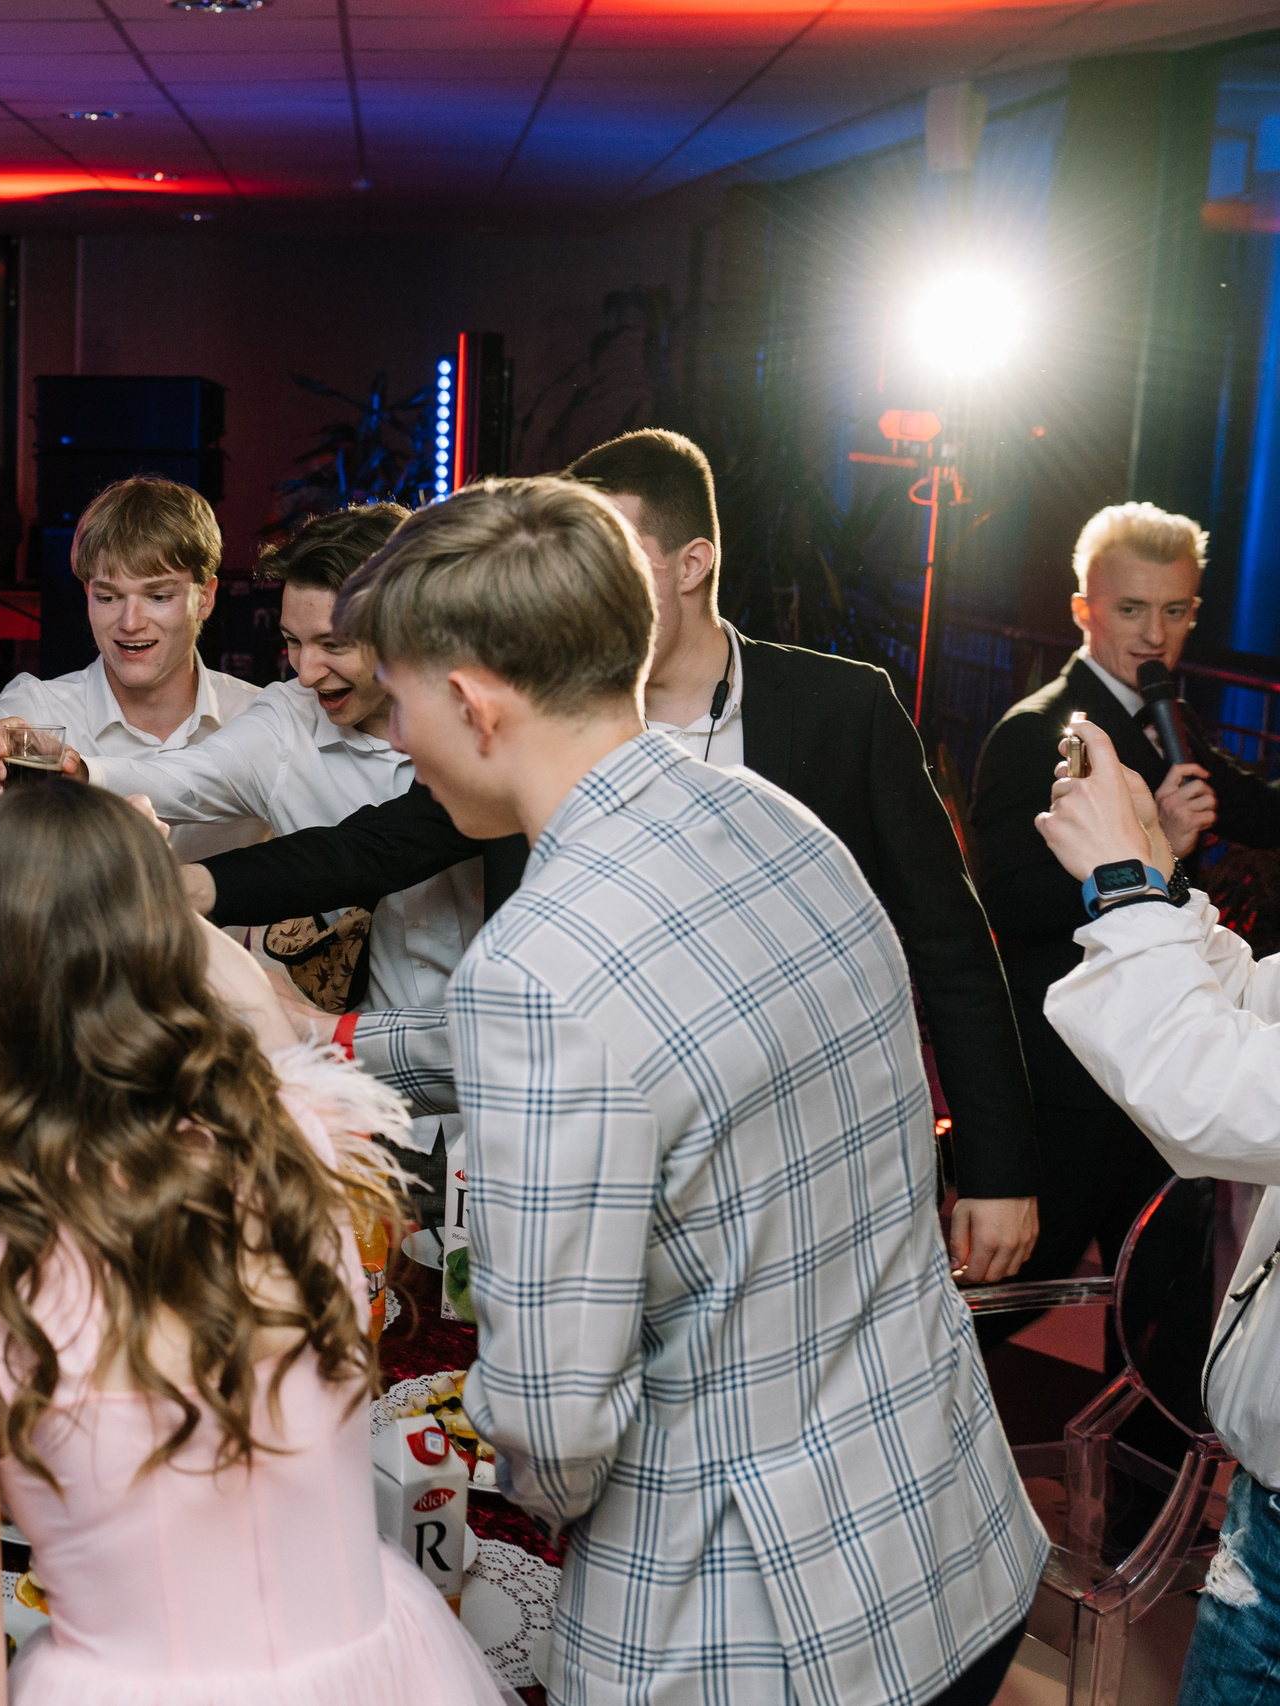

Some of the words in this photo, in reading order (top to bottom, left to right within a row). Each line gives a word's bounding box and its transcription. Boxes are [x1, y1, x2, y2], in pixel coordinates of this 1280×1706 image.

[451, 1232, 469, 1242] Ябло
[418, 1491, 449, 1509] Rich
[414, 1520, 453, 1572] R
